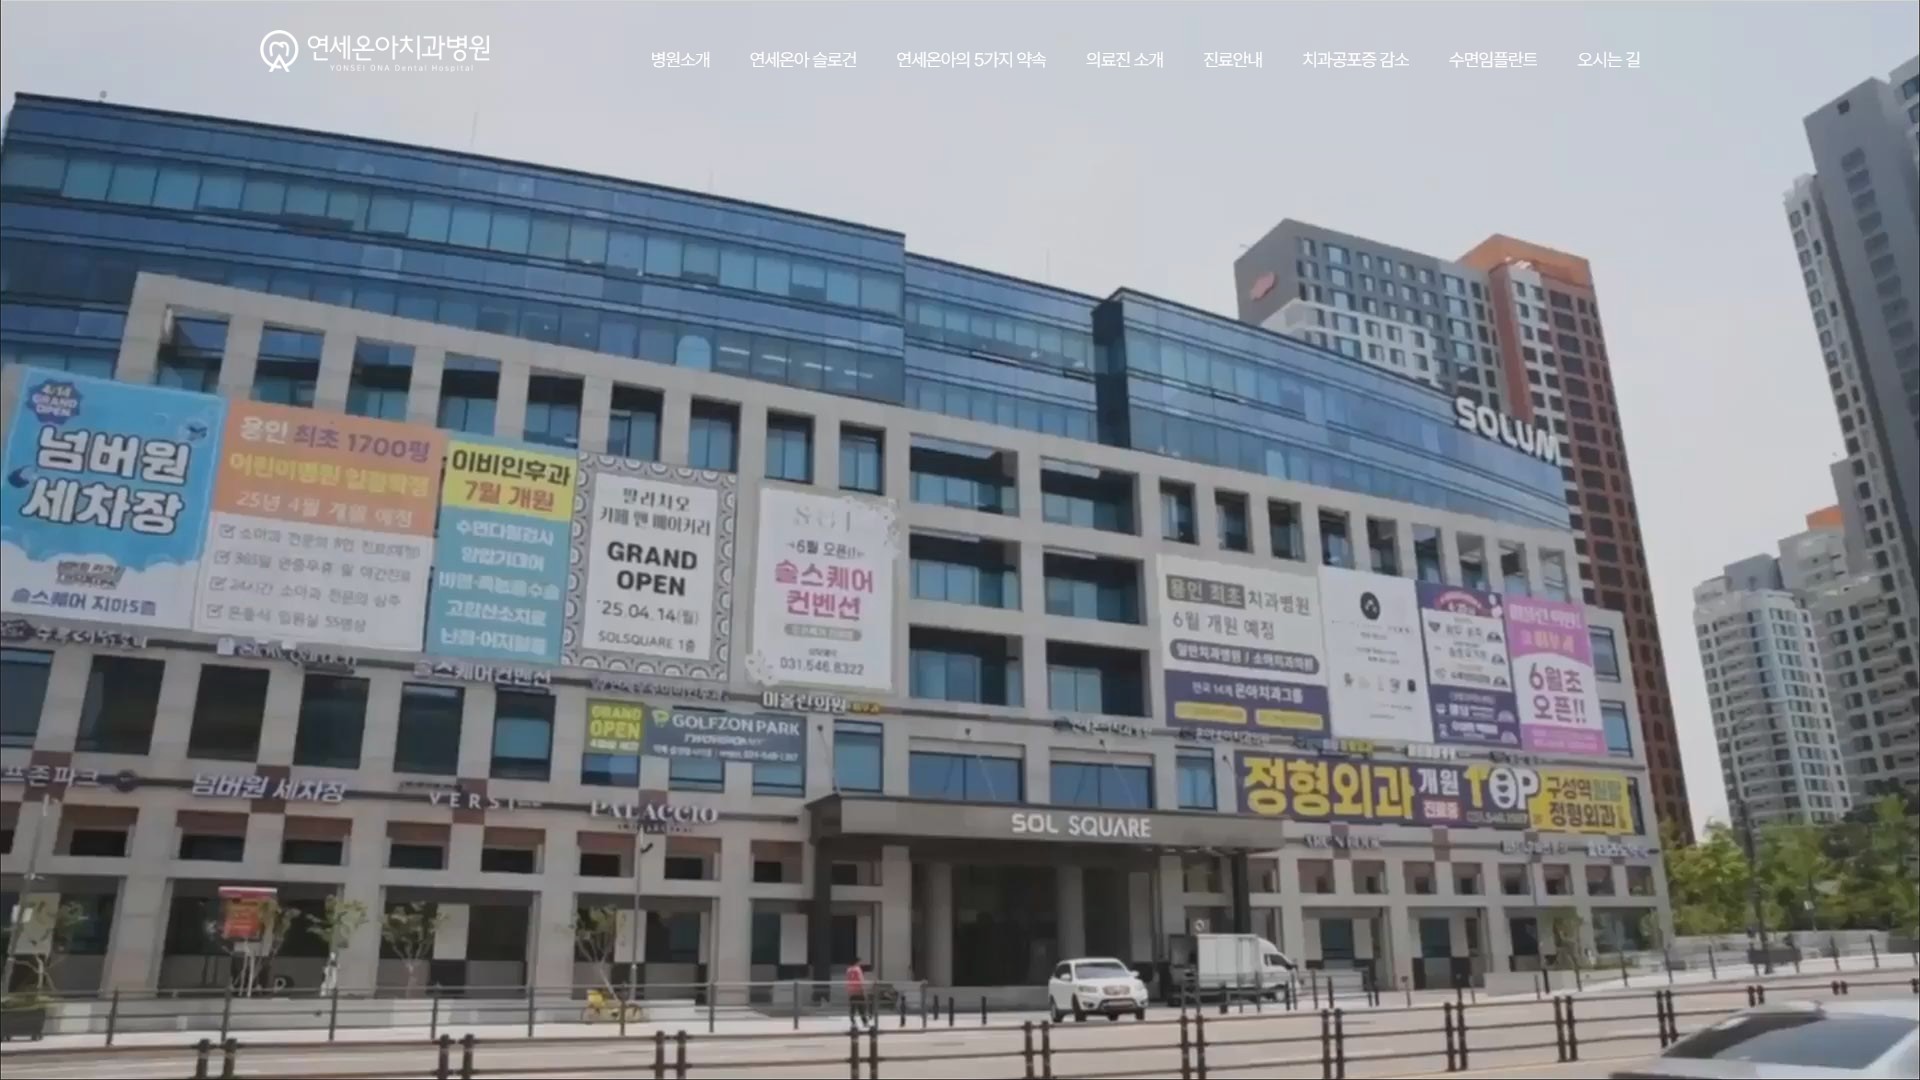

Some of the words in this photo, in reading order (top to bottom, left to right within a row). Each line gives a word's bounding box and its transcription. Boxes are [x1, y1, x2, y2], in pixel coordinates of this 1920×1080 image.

[240, 416, 288, 444] 용인
[294, 424, 340, 450] 최초
[347, 433, 431, 463] 1700평
[1456, 396, 1561, 466] SOLUM
[37, 426, 192, 486] 넘버원
[452, 448, 571, 487] 이비인후과
[19, 478, 184, 535] 세차장
[465, 480, 501, 505] 7월
[508, 487, 555, 513] 개원
[607, 541, 698, 571] GRAND
[617, 570, 685, 597] OPEN
[787, 589, 860, 621] 컨벤션
[1248, 590, 1311, 617] 치과병원
[598, 631, 673, 650] SOLSQUARE
[1172, 611, 1200, 632] 6월
[1207, 614, 1238, 636] 개원
[1243, 619, 1275, 641] 예정
[1530, 662, 1584, 693] 6월초
[592, 705, 642, 721] GRAND
[1533, 695, 1586, 723] 오픈!!
[590, 721, 640, 740] OPEN
[672, 714, 753, 734] GOLFZON
[756, 720, 800, 736] PARK
[191, 774, 269, 799] 넘버원
[273, 778, 348, 803] 세차장
[1243, 756, 1415, 819] 정형외과
[1418, 768, 1460, 796] 개원
[1464, 764, 1540, 810] TOP
[1547, 776, 1592, 801] 구성역
[591, 799, 718, 823] PALACCIO
[1012, 813, 1059, 834] SOL
[1068, 815, 1152, 838] SQUARE
[1549, 801, 1616, 828] 정형외과
